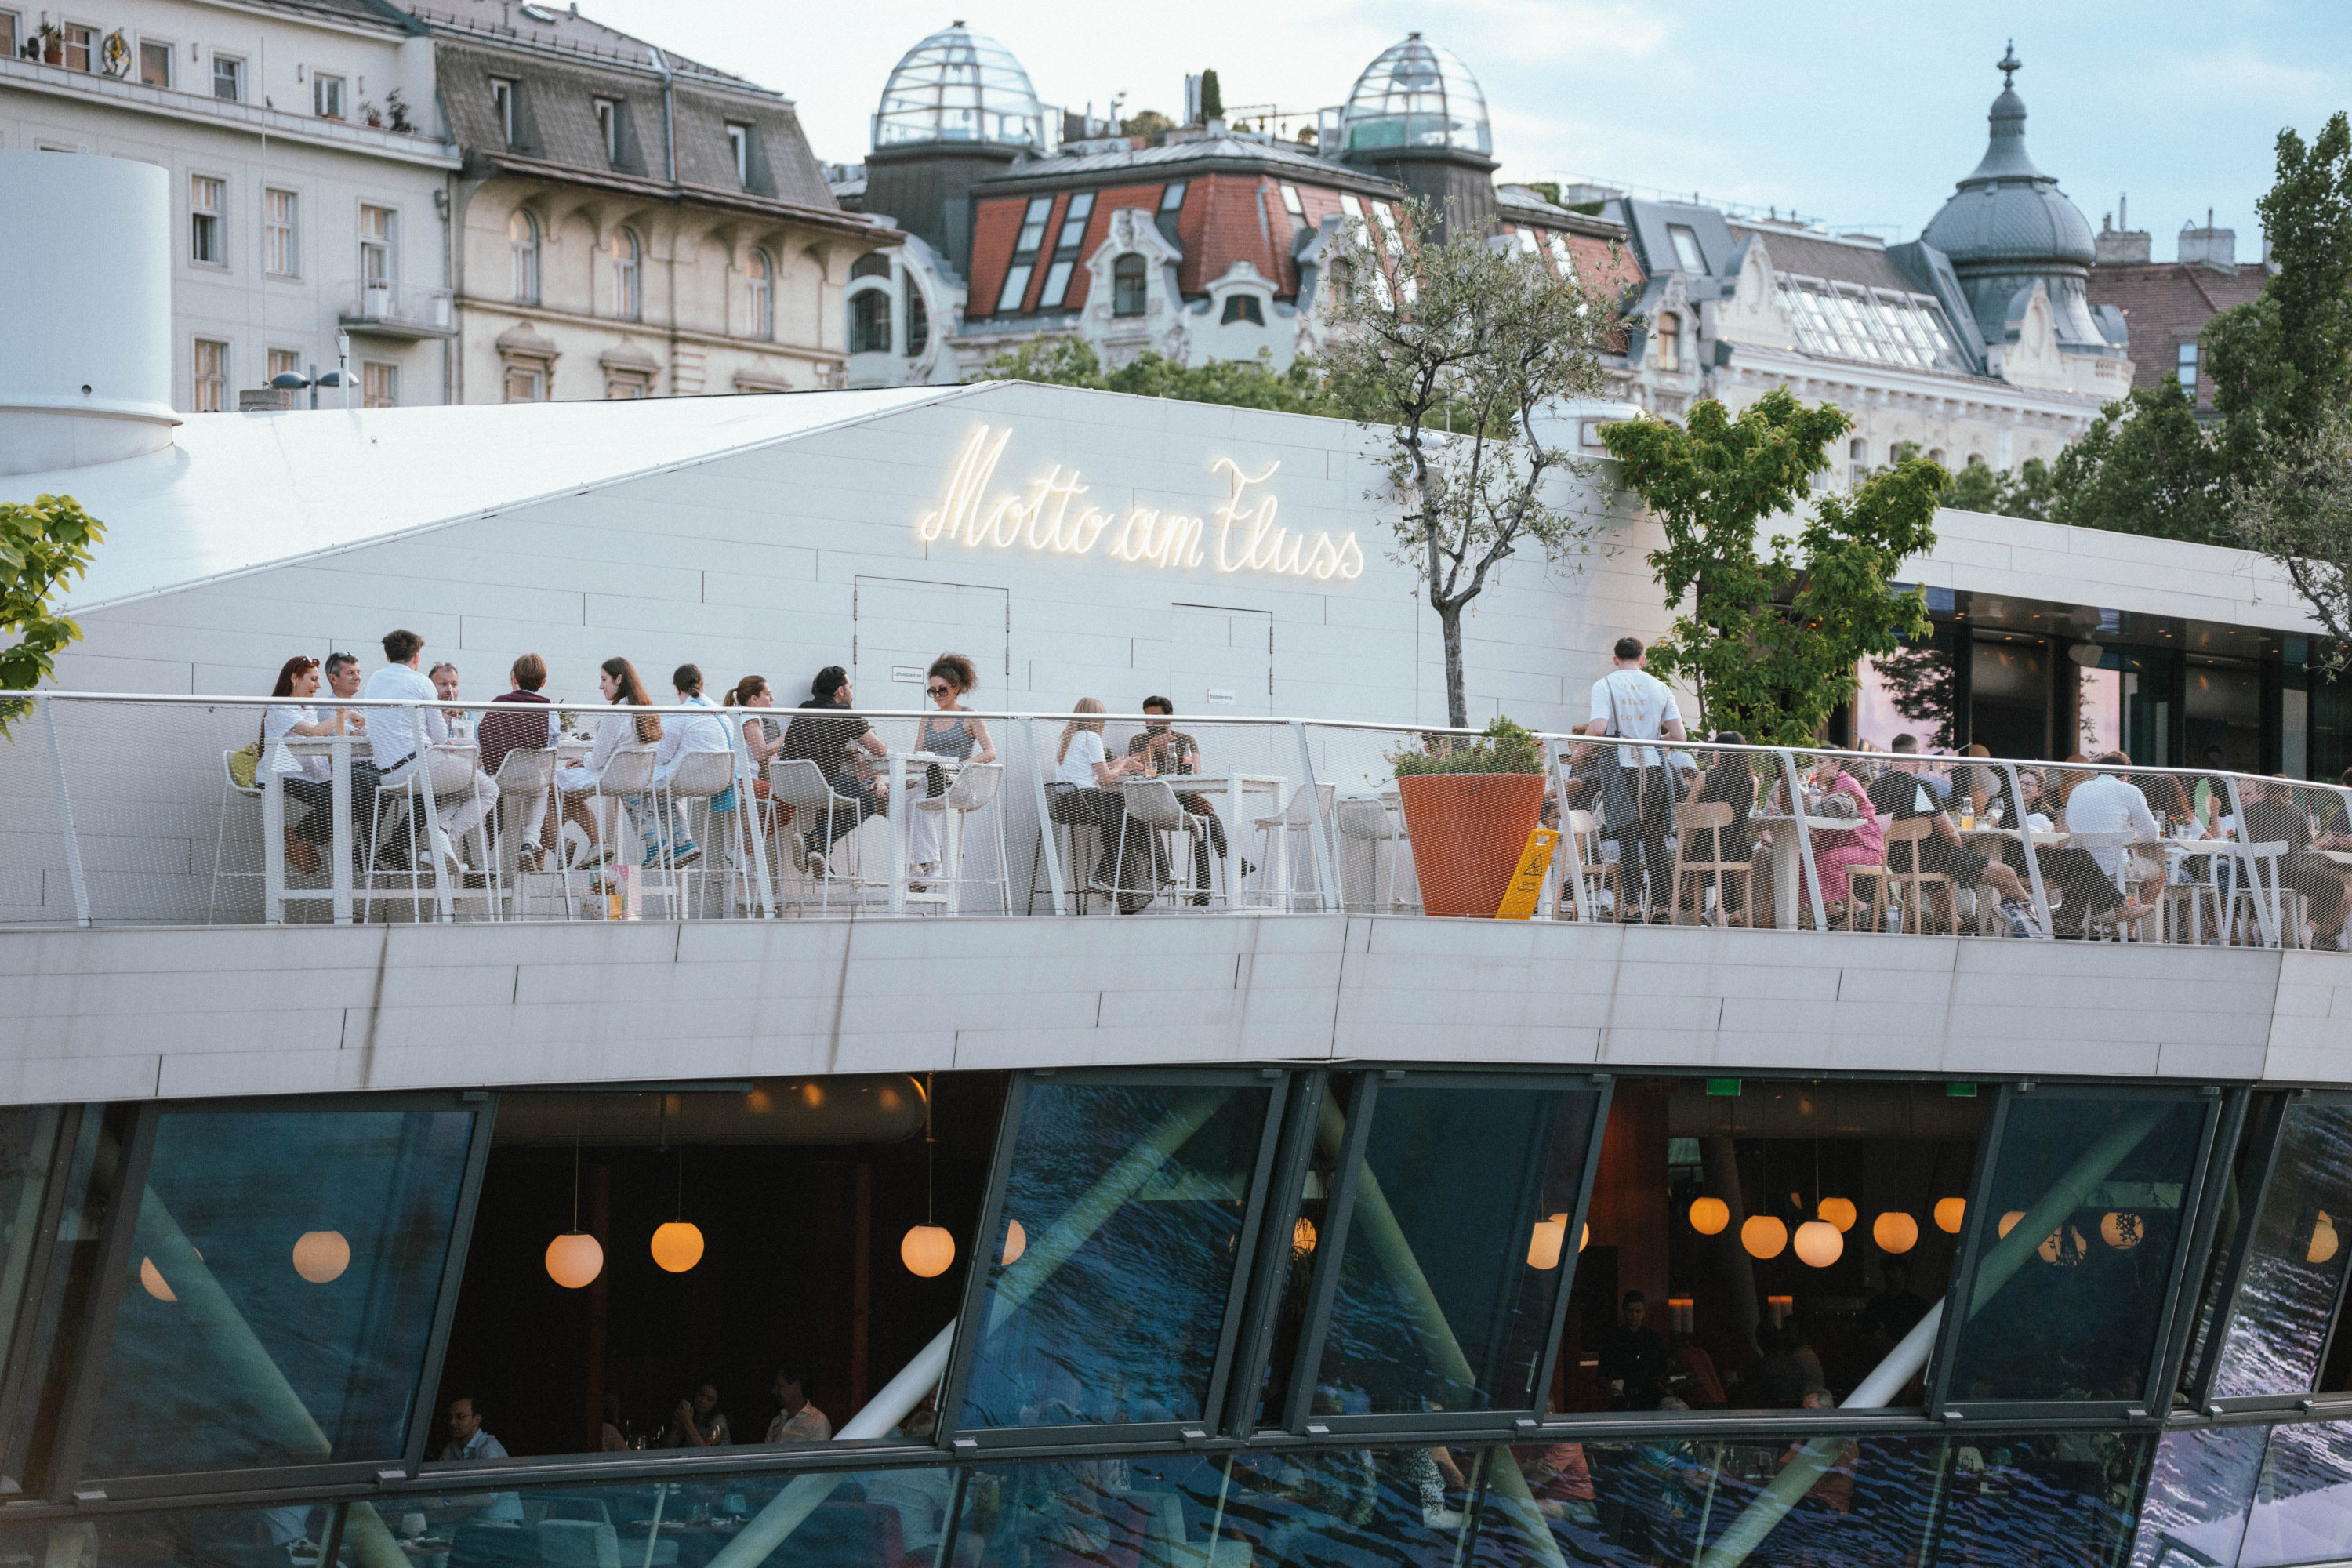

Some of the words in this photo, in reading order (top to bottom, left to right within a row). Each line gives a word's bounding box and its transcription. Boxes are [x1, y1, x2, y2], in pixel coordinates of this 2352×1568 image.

[920, 424, 1115, 554] Motto
[1110, 508, 1205, 568] am
[1211, 457, 1365, 579] Fluss
